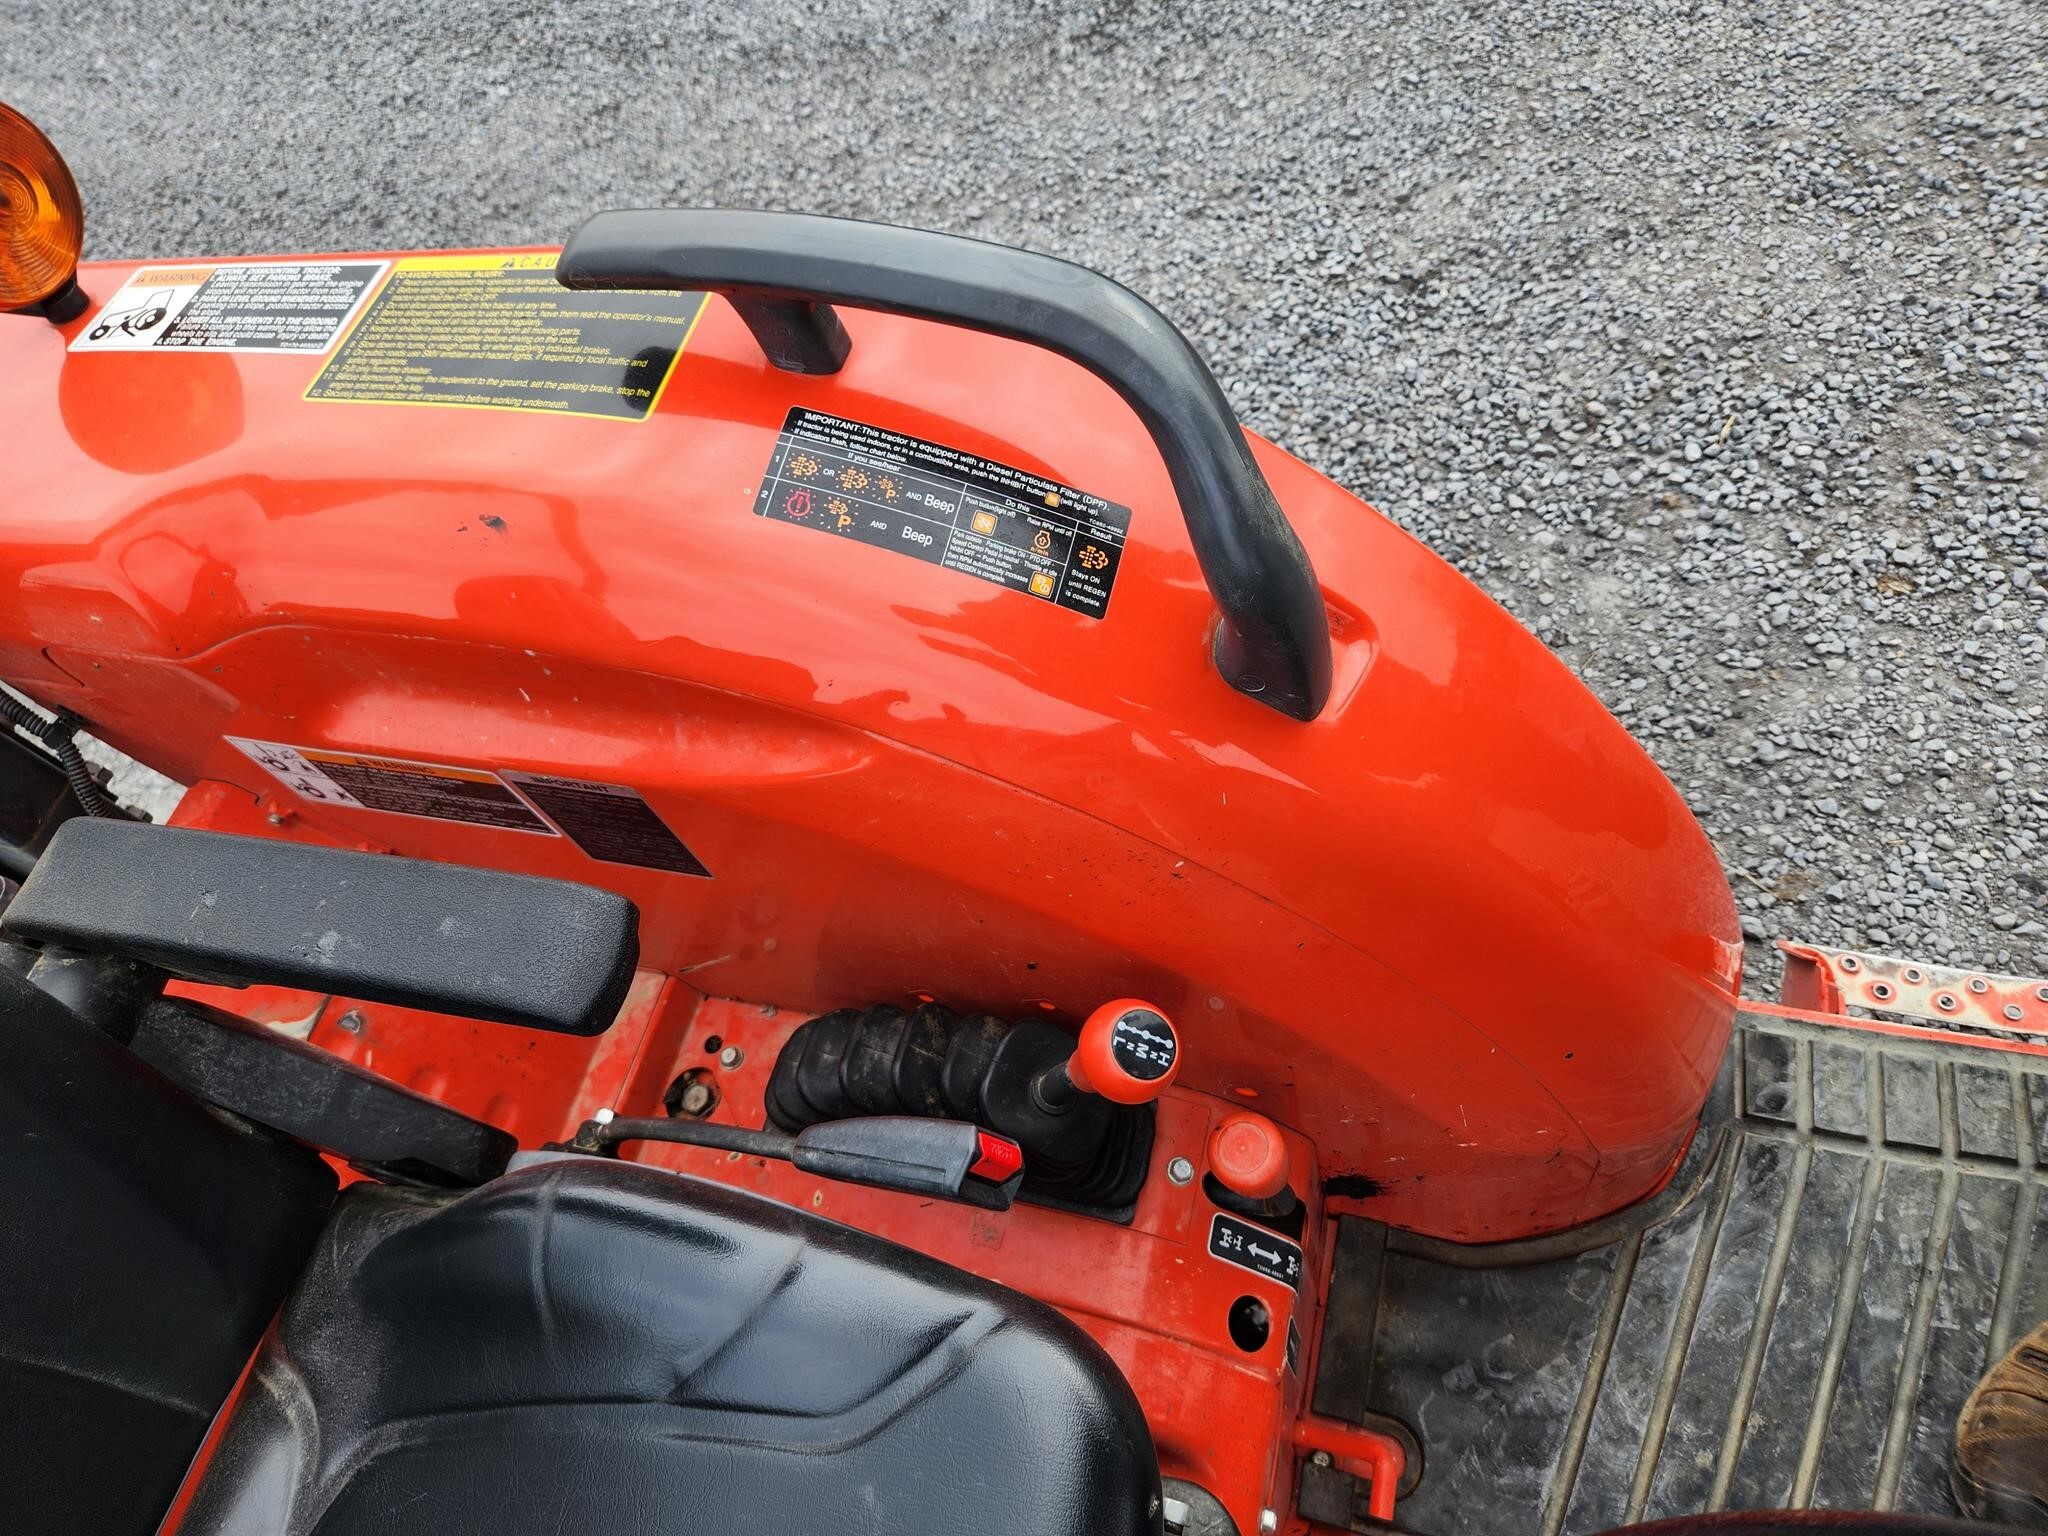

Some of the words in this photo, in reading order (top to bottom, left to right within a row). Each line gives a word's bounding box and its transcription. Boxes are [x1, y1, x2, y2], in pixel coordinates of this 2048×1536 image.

[580, 311, 599, 319] read
[598, 311, 611, 319] the
[612, 313, 653, 321] operator's
[582, 345, 611, 355] brakes.
[574, 355, 587, 365] by
[586, 355, 607, 364] local
[607, 357, 630, 366] traffic
[630, 359, 648, 368] and
[530, 380, 543, 388] set
[543, 380, 557, 389] the
[557, 382, 588, 393] parking
[615, 387, 635, 397] stop
[636, 388, 650, 398] the
[799, 429, 830, 442] indicators
[830, 437, 849, 448] flash,
[849, 442, 868, 452] follow
[868, 447, 886, 457] chart
[886, 452, 908, 463] below.
[802, 421, 823, 431] tractor
[830, 428, 849, 439] being
[849, 433, 865, 442] used
[866, 437, 892, 450] indoors,
[914, 451, 953, 467] combustible
[953, 462, 970, 473] area,
[971, 468, 987, 478] push
[988, 473, 999, 481] the
[1000, 477, 1026, 490] INHIBIT
[1026, 485, 1046, 497] button
[1072, 502, 1087, 512] light
[853, 454, 867, 463] you
[868, 458, 900, 471] see/hear
[861, 427, 879, 437] This
[880, 431, 908, 445] tractor
[909, 439, 918, 448] is
[918, 442, 958, 460] equipped
[959, 454, 977, 465] with
[978, 460, 985, 468] a
[986, 463, 1013, 477] Diesel
[1014, 472, 1058, 492] Particulate
[1059, 487, 1080, 500] Filter
[1082, 494, 1110, 511] (DPF).
[822, 467, 835, 476] OR
[905, 490, 922, 501] AND
[922, 493, 955, 515] Beep
[964, 496, 978, 505] Push
[1004, 499, 1016, 507] Do
[1016, 503, 1030, 512] this
[760, 489, 768, 498] 2
[870, 519, 887, 530] AND
[900, 525, 934, 548] Beep
[836, 514, 852, 530] P
[1026, 516, 1041, 526] Raise
[1041, 522, 1054, 530] RPM
[1054, 526, 1064, 534] until
[1090, 527, 1112, 540] Result
[951, 537, 967, 546] Speed
[967, 542, 984, 552] Control
[1023, 560, 1042, 571] Throttle
[953, 530, 964, 538] Park
[985, 540, 1003, 552] Parking
[1003, 546, 1016, 554] brake
[1040, 558, 1051, 566] OFF
[1030, 546, 1049, 556] n/min
[981, 554, 996, 563] Push
[956, 562, 976, 573] REGEN
[959, 555, 972, 563] RPM
[1004, 570, 1028, 582] increases
[1070, 569, 1089, 580] Stays
[1089, 575, 1100, 584] ON
[1068, 579, 1082, 588] until
[1082, 584, 1106, 597] REGEN
[1071, 593, 1101, 607] complete.
[531, 776, 609, 793] IMPORTANT
[1113, 1036, 1126, 1046] L
[1158, 1052, 1170, 1066] H
